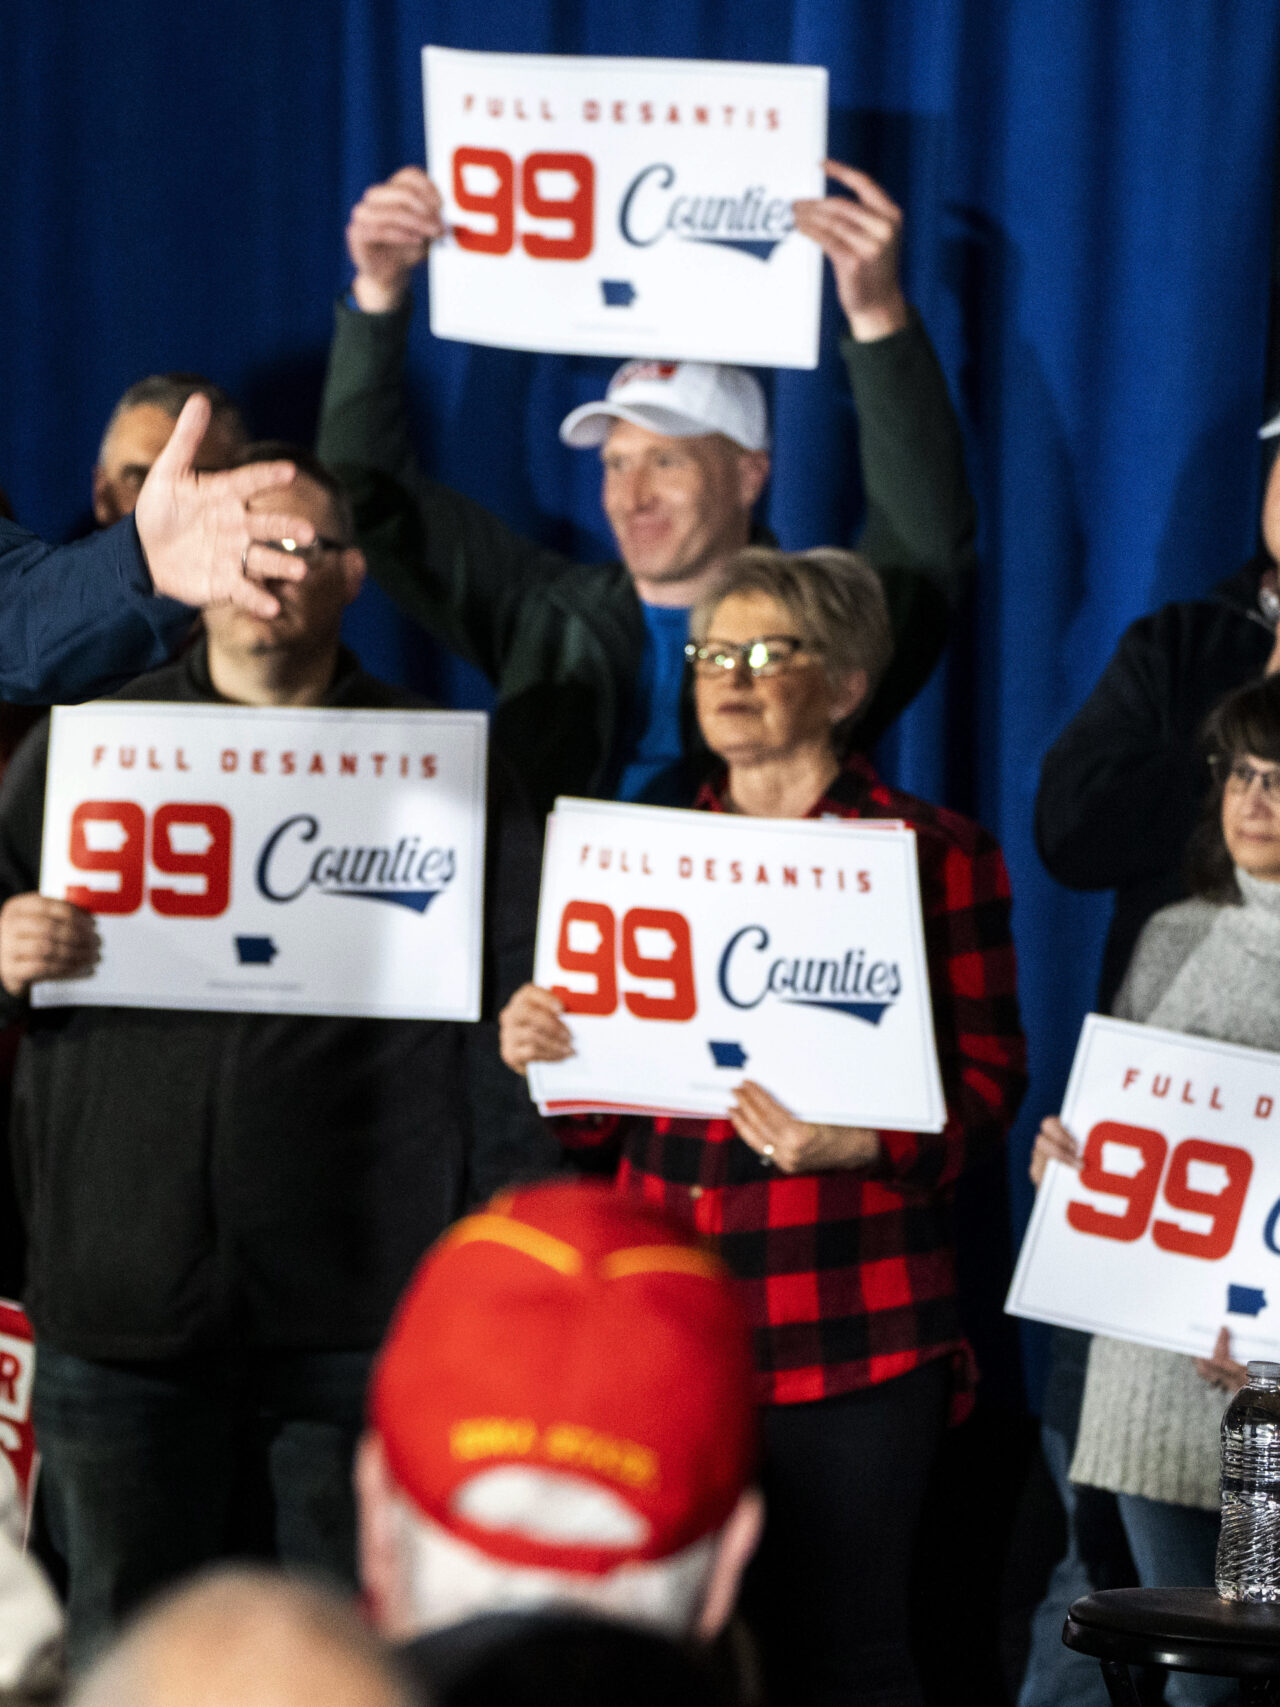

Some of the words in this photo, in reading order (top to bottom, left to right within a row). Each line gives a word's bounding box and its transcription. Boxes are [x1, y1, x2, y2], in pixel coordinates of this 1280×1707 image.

[464, 94, 555, 121] FULL
[583, 100, 781, 131] DESANTIS
[451, 145, 596, 262] 99
[91, 745, 189, 772] FULL
[220, 748, 439, 780] DESANTIS
[65, 800, 233, 919] 99
[254, 813, 457, 903] Counties
[581, 845, 652, 875] FULL
[678, 855, 873, 894] DESANTIS
[550, 899, 699, 1022] 99
[717, 925, 903, 1010] Counties
[1122, 1067, 1223, 1111] FULL
[1066, 1120, 1254, 1262] 99
